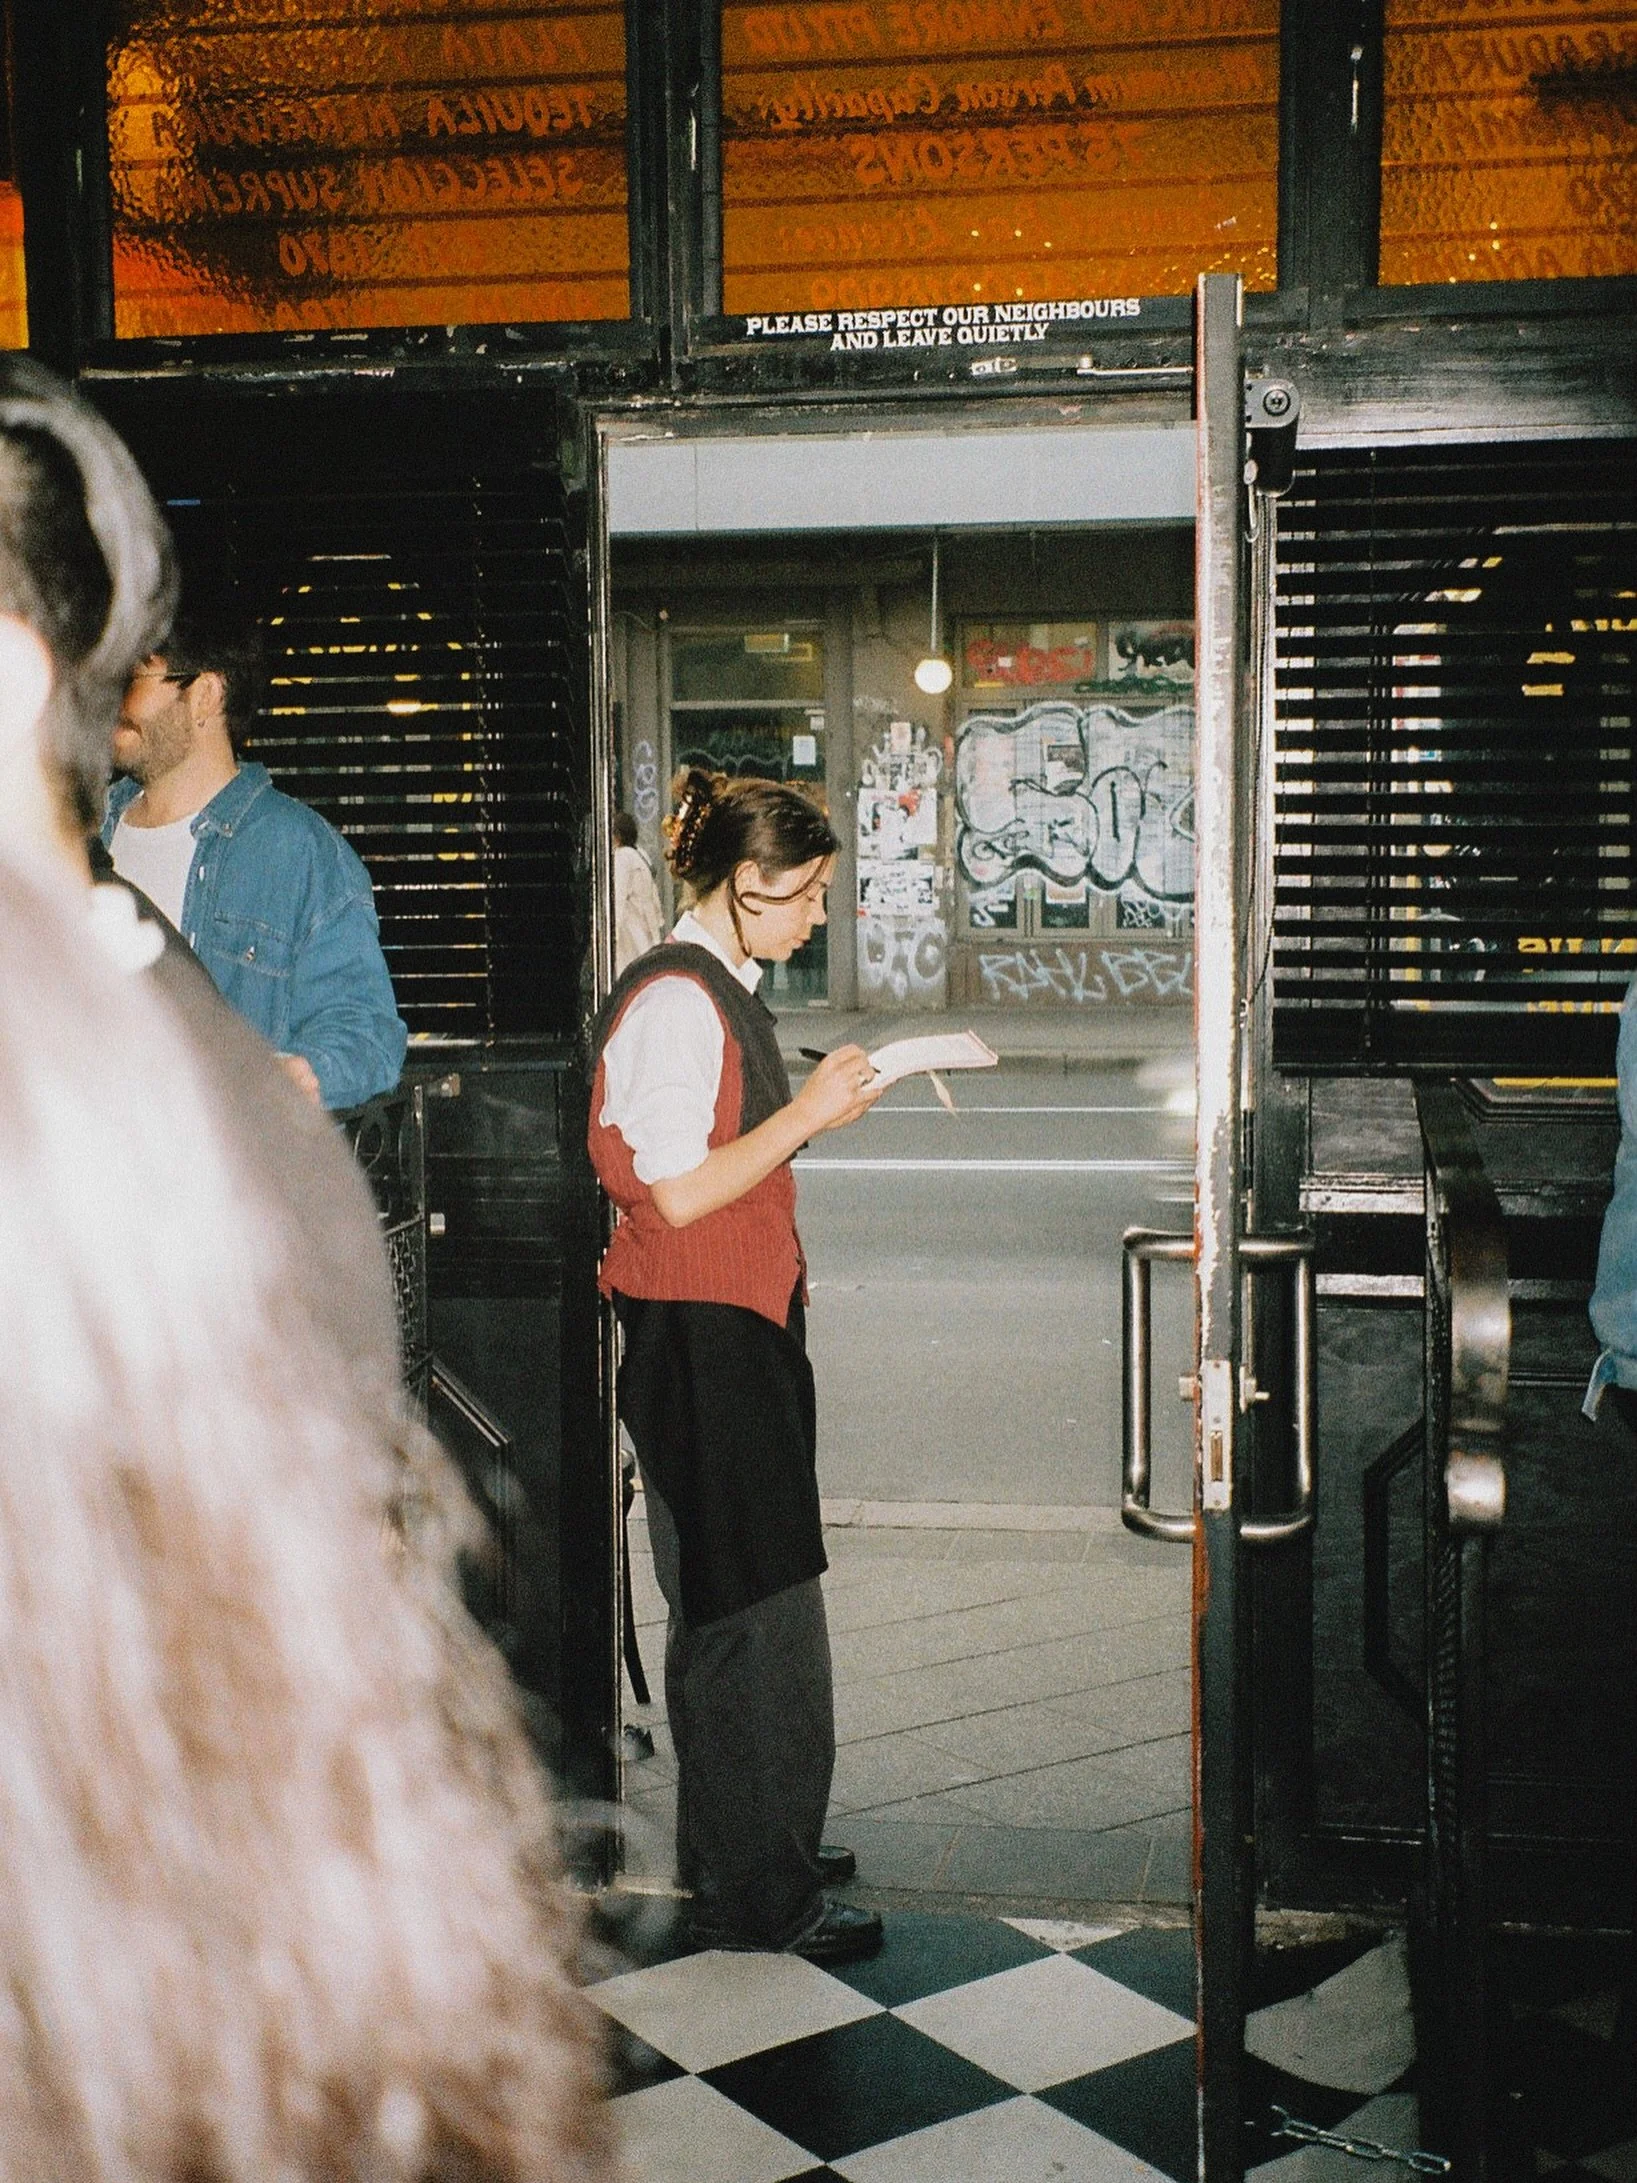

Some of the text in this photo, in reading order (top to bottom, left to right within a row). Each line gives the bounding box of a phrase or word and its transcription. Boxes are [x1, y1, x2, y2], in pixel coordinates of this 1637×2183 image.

[745, 298, 1141, 336] PLEASE RESPECT OUR NEIGHBOURS
[829, 322, 1050, 352] AND LEAVE QUIETLY
